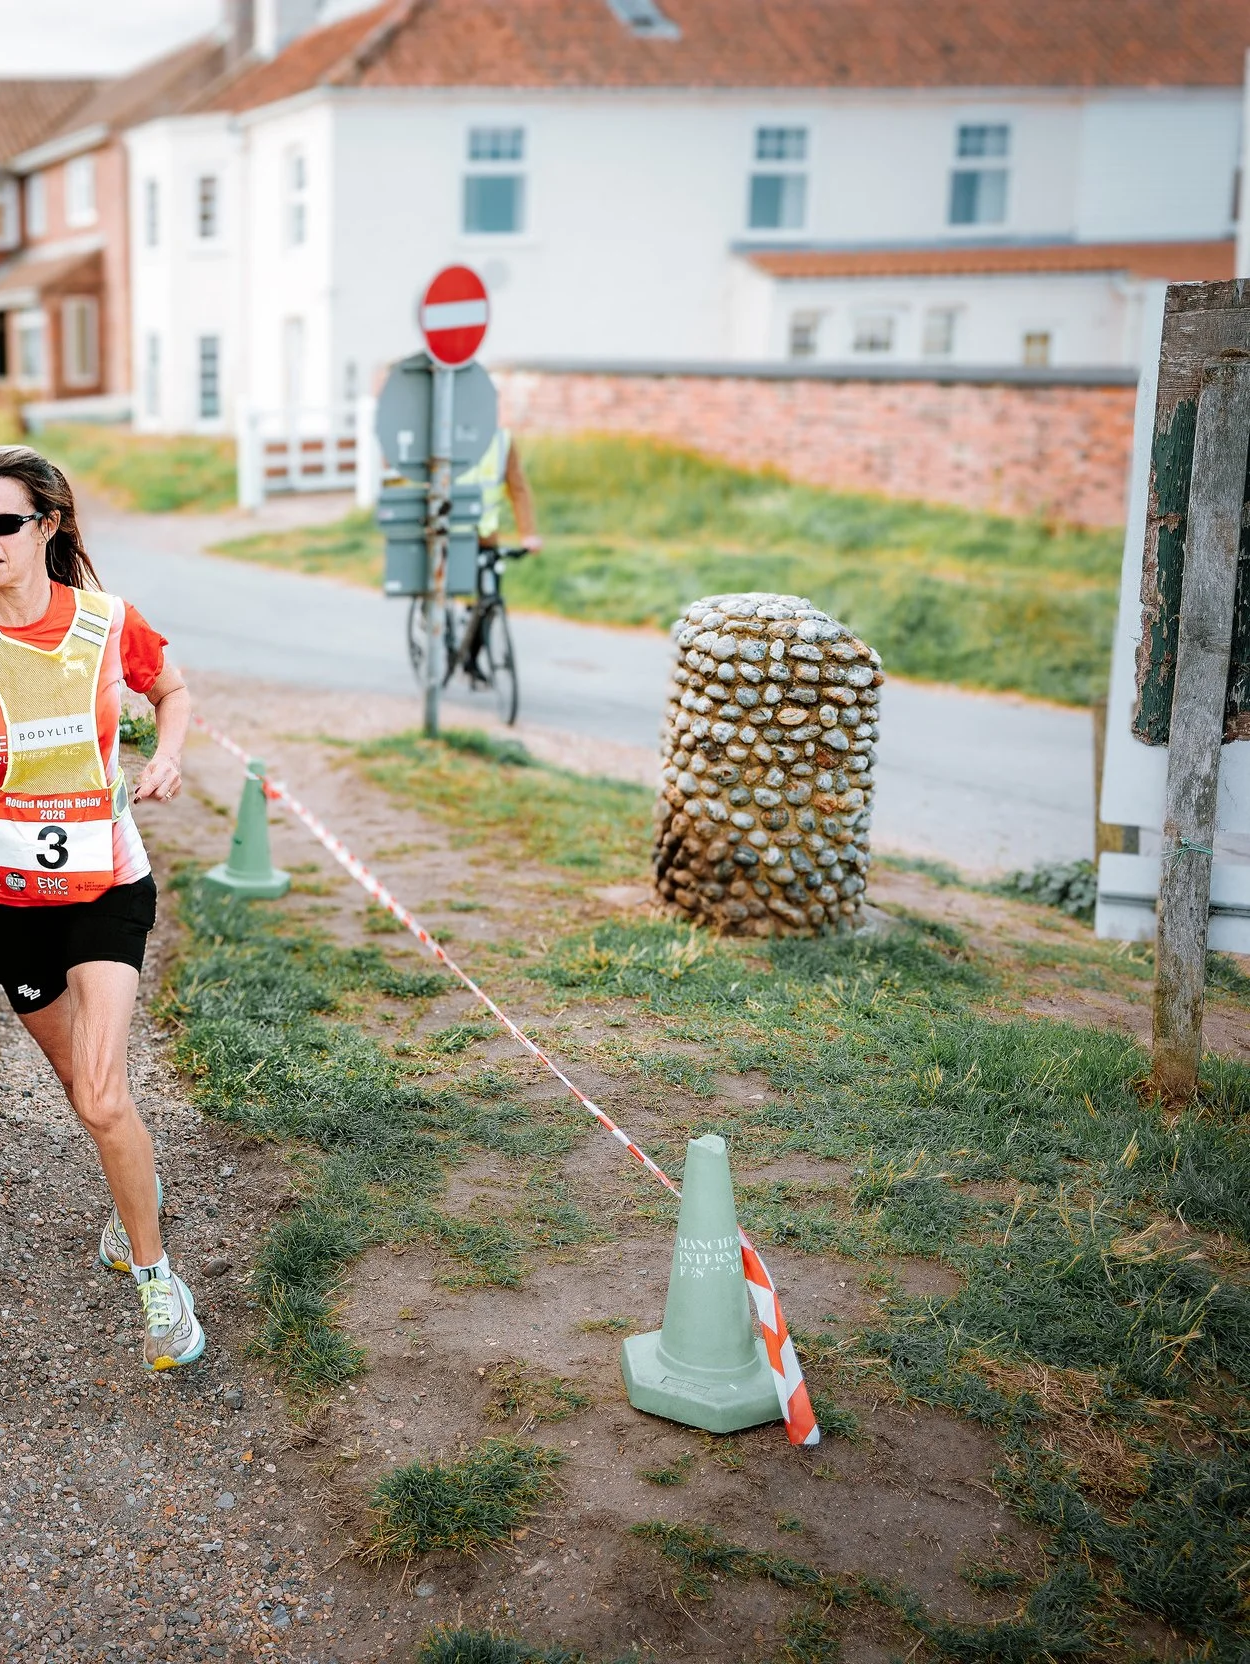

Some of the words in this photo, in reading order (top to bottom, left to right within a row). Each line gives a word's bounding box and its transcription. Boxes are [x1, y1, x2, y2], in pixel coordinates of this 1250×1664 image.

[19, 724, 84, 741] BODYLITE
[5, 796, 35, 809] Round
[36, 798, 74, 809] Norfolk
[75, 796, 102, 808] Relay
[40, 809, 66, 820] 2026
[36, 825, 69, 870] 3
[37, 876, 69, 890] EPIC
